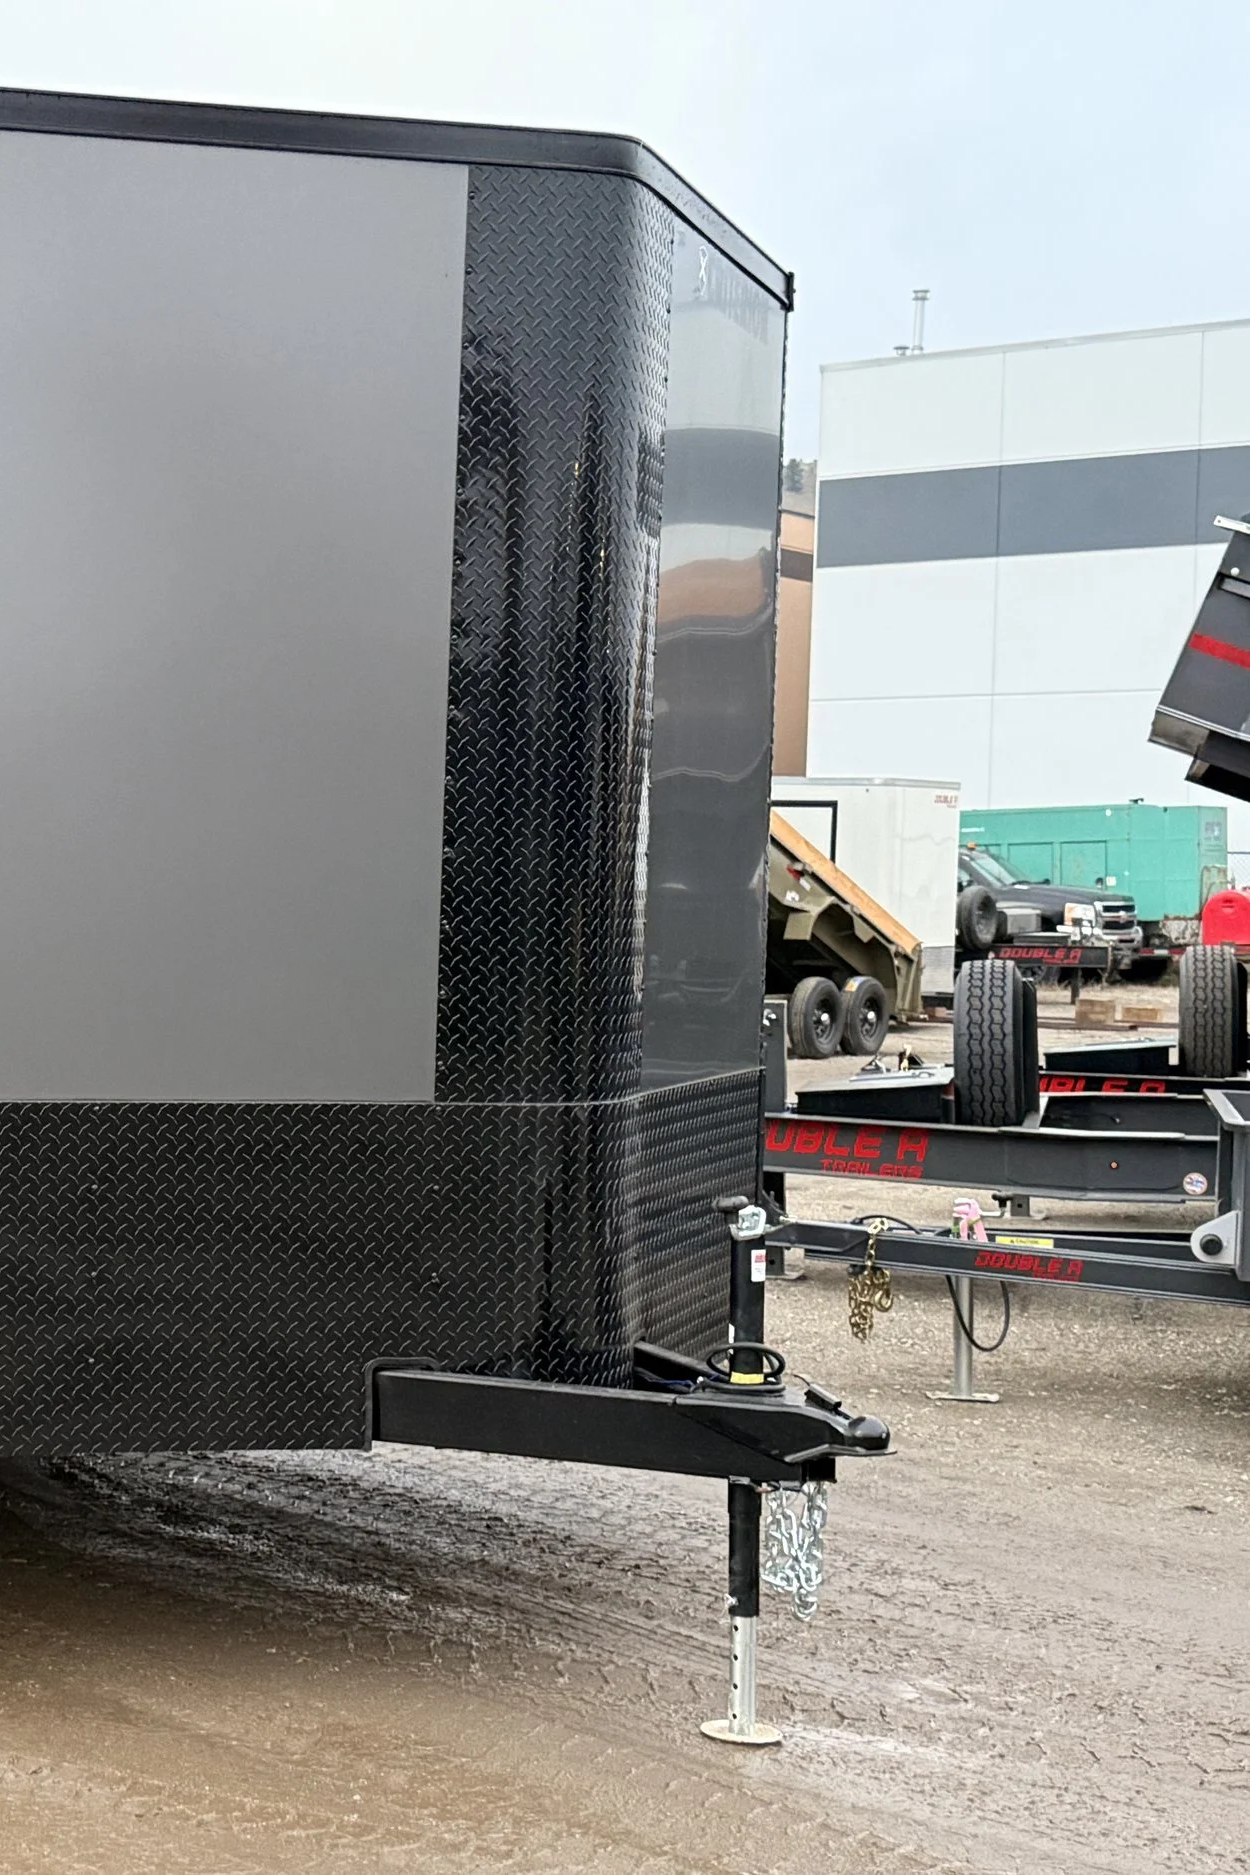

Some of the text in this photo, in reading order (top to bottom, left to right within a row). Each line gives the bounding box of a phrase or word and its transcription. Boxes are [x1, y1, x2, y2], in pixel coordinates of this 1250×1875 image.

[999, 948, 1083, 960] DOUBLE A
[764, 1119, 929, 1162] UBLE A
[820, 1159, 924, 1180] TRAILERS
[974, 1251, 1084, 1276] DOUBLE A
